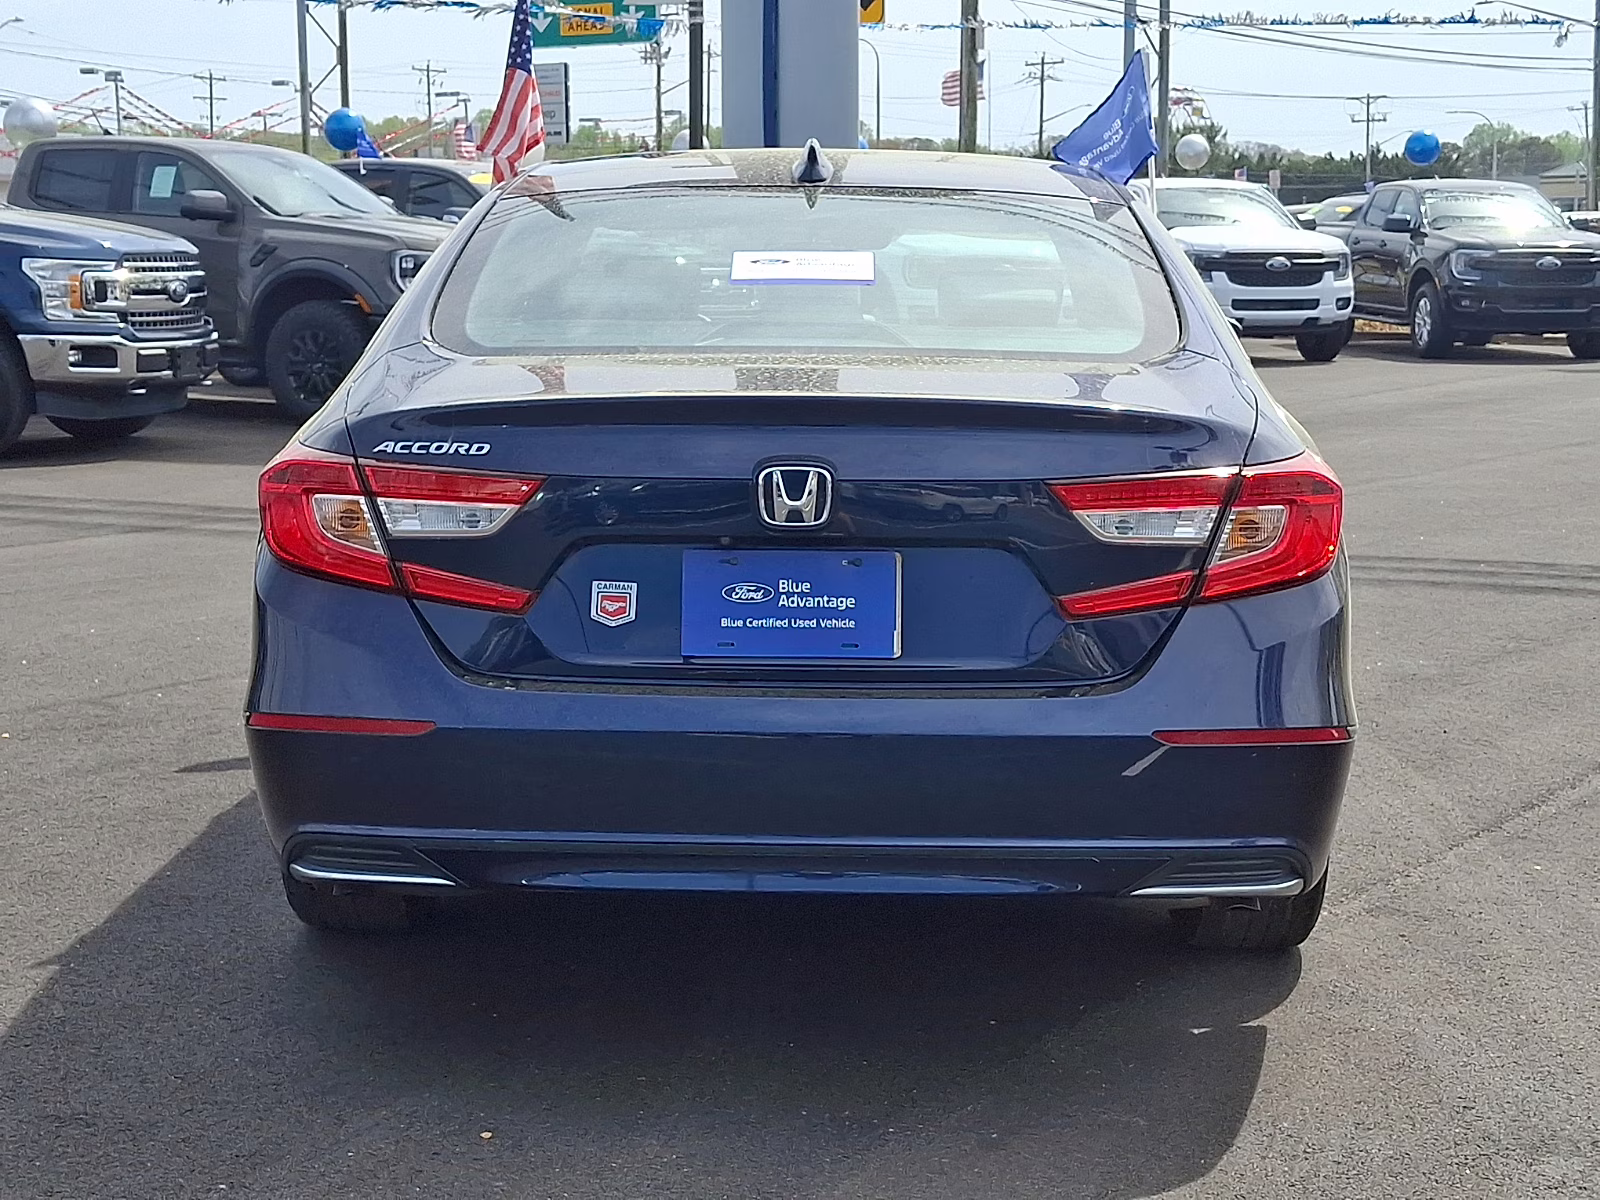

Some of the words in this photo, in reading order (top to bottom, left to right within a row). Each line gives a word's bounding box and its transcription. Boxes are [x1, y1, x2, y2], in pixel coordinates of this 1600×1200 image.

[372, 441, 491, 455] ACCORD
[596, 582, 633, 591] CARMAN
[731, 585, 764, 600] Ford
[778, 579, 811, 593] Blue
[778, 594, 856, 610] Advantage
[720, 617, 744, 627] Blue
[746, 617, 789, 628] Certified
[791, 618, 817, 628] Used
[819, 618, 856, 628] Vehicle
